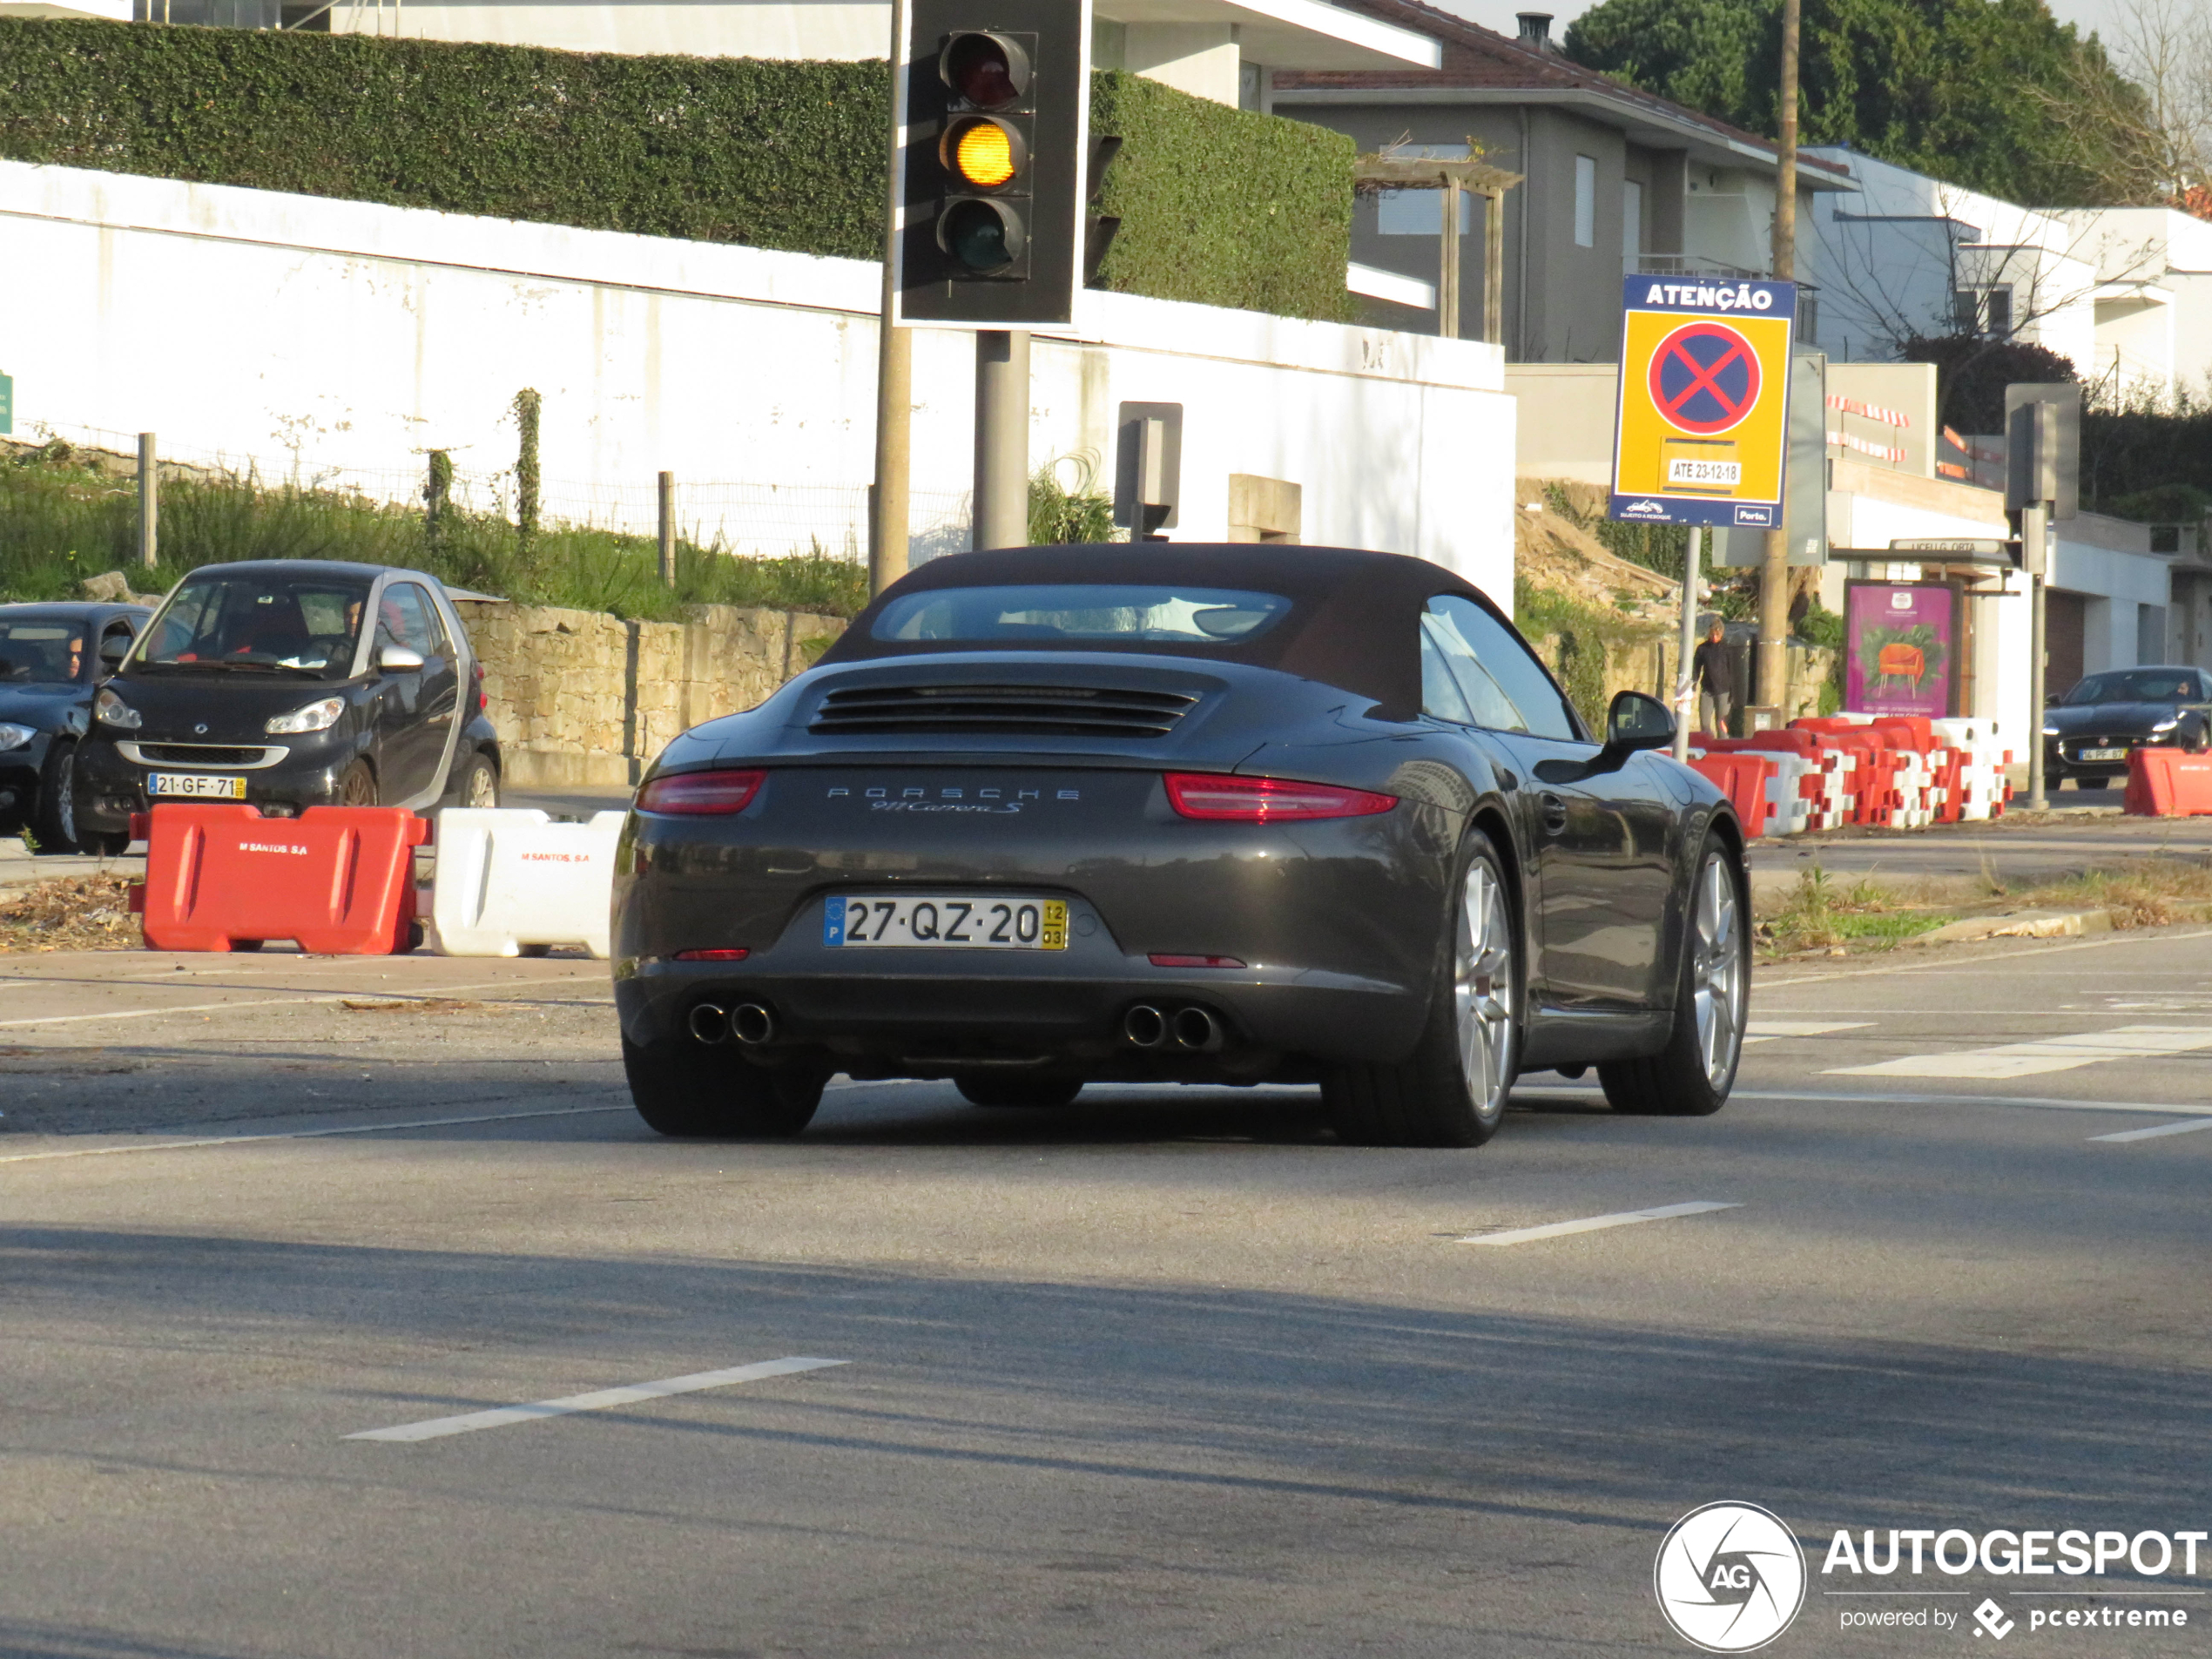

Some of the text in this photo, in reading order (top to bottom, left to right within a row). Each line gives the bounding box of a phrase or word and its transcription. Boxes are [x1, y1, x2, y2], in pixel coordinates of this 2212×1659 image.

[1646, 284, 1773, 311] ATENÇÃO
[1674, 461, 1737, 480] ATÉ 23-12-18
[1740, 510, 1767, 521] Porto.
[827, 788, 1080, 799] PORSCHE
[908, 801, 993, 812] Carrera
[1047, 907, 1062, 921] 12
[1043, 930, 1061, 944] 03
